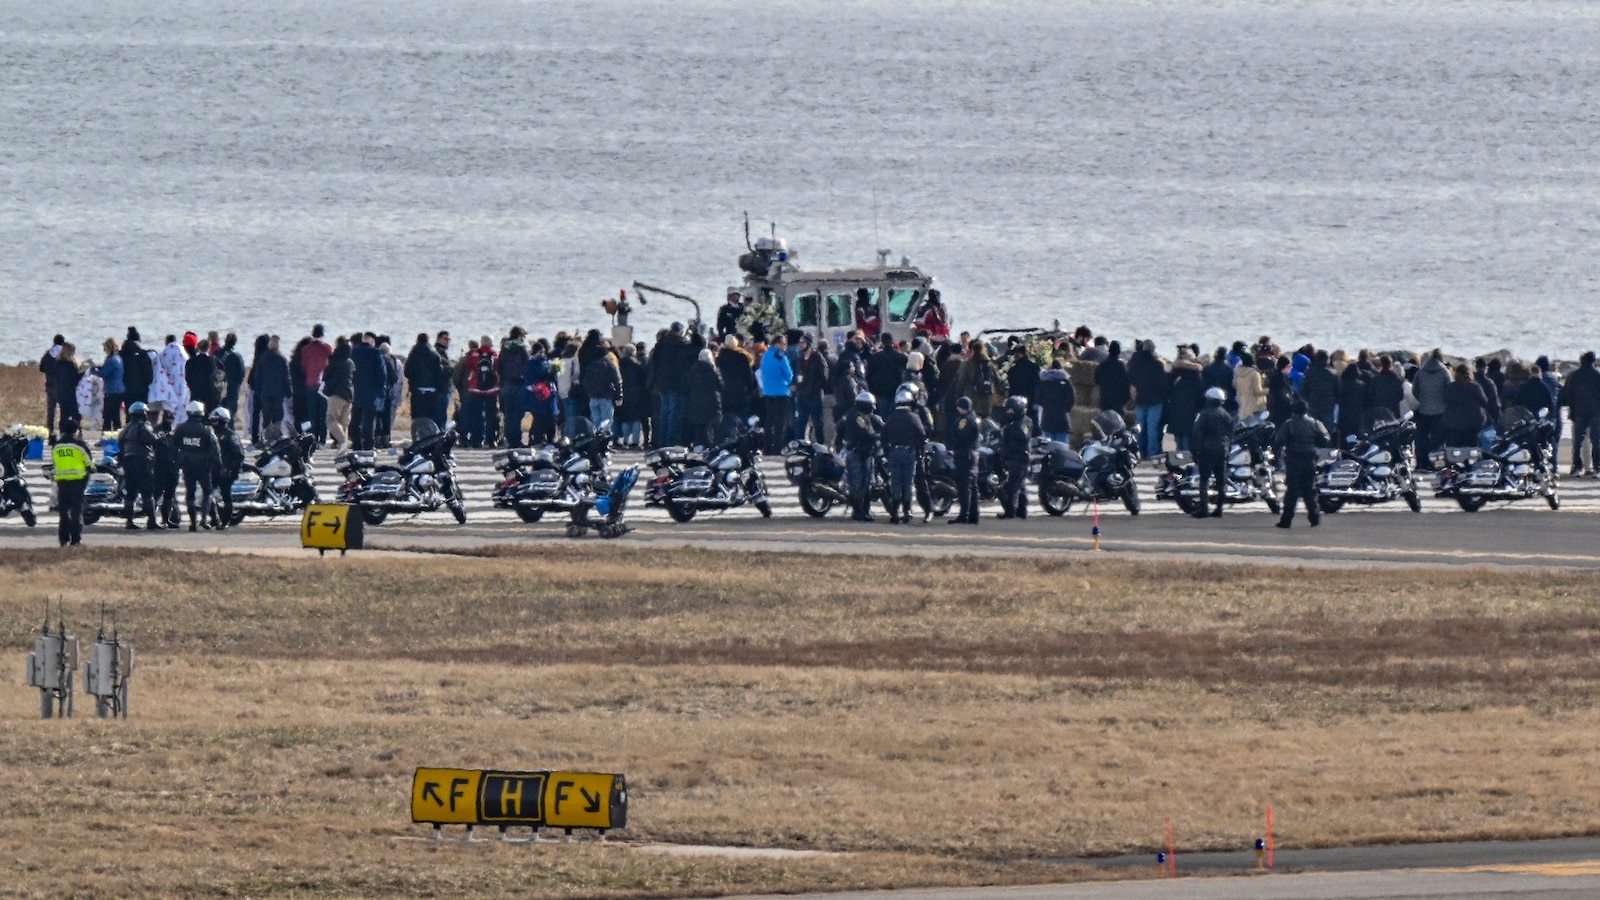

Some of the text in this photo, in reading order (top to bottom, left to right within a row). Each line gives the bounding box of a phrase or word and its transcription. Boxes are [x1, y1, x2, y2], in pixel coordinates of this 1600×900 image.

[307, 511, 322, 538] F
[449, 778, 574, 816] F H F
